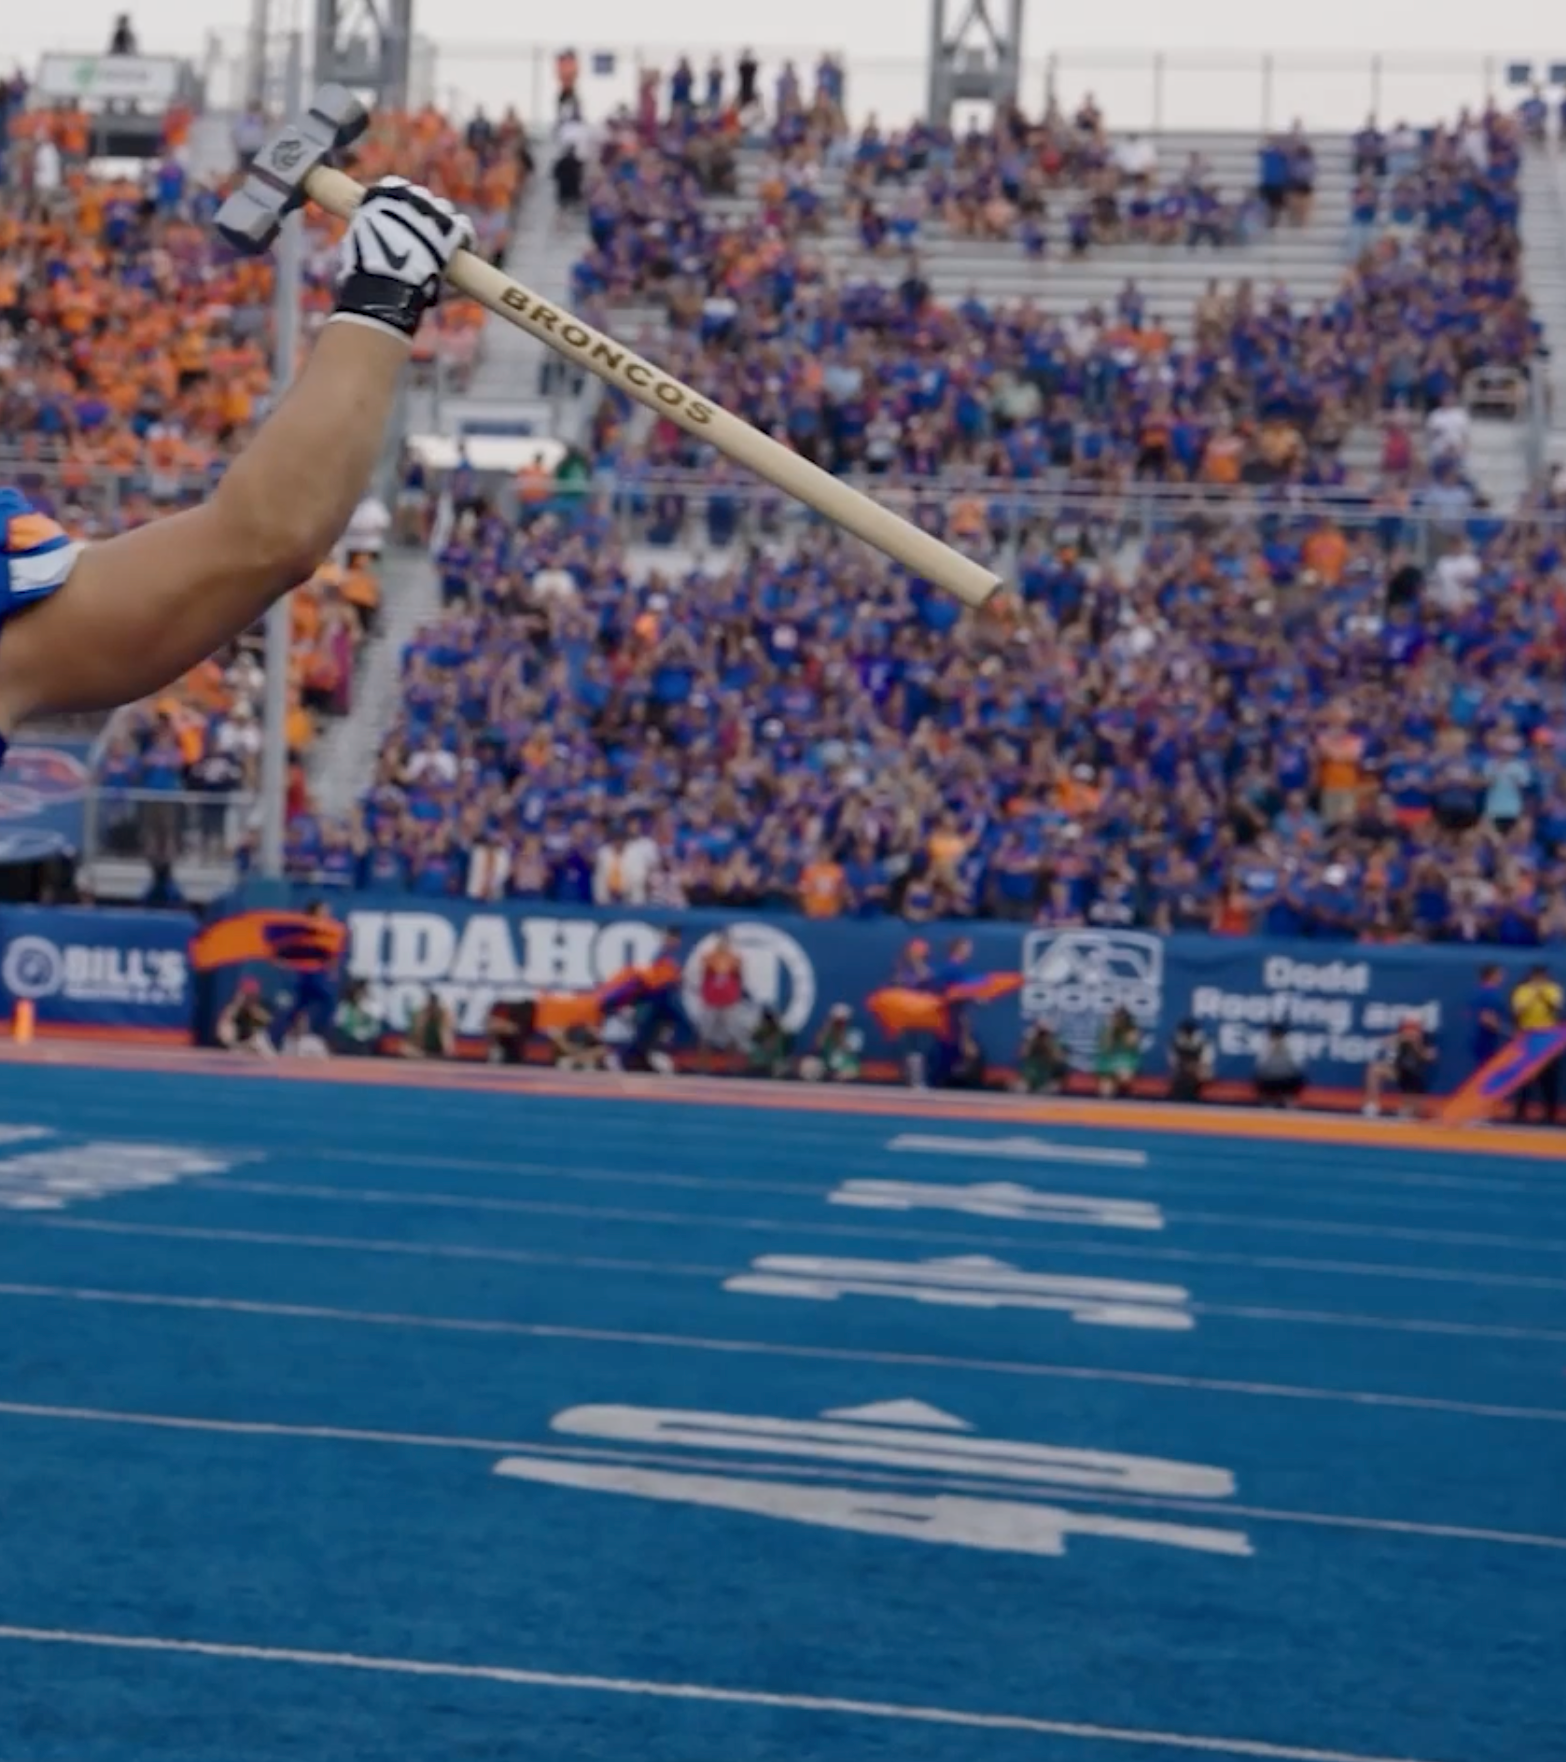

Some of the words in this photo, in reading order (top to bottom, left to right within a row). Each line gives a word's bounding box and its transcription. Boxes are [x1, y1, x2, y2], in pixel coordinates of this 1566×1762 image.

[500, 287, 715, 424] BRONCOS
[1264, 956, 1369, 993] Dodd
[1192, 987, 1352, 1034] Roofing
